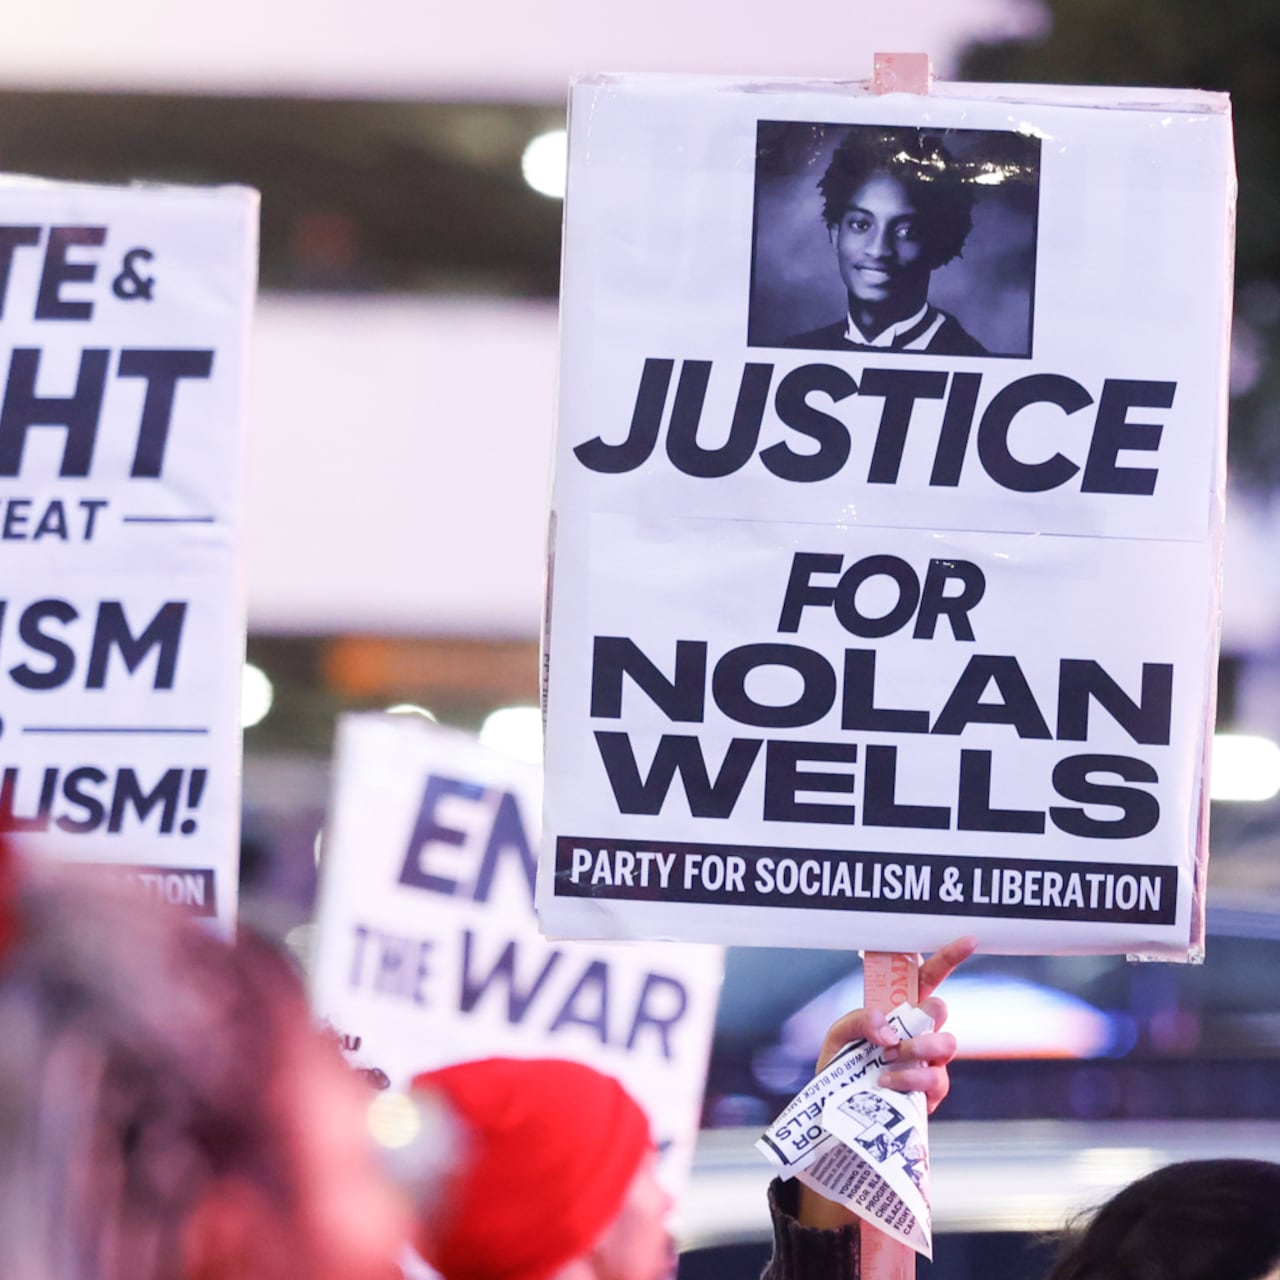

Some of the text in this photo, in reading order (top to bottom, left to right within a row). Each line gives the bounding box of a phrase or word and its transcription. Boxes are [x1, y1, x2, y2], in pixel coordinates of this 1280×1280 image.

[111, 248, 156, 302] &
[573, 358, 1177, 495] JUSTICE
[777, 552, 986, 642] FOR
[590, 635, 1173, 746] NOLAN
[593, 730, 1160, 839] WELLS
[571, 848, 1162, 912] PARTY FOR SOCIALISM & LIBERATION
[458, 929, 689, 1060] WAR
[830, 1067, 844, 1080] ON
[845, 1054, 864, 1071] WAR
[803, 1079, 831, 1099] BLACK
[775, 1095, 827, 1141] ELLS
[792, 1125, 827, 1150] OR
[838, 1169, 859, 1195] YOUNG
[855, 1189, 870, 1206] FOR
[865, 1180, 890, 1212] PROGRE
[874, 1190, 898, 1218] CHILDR
